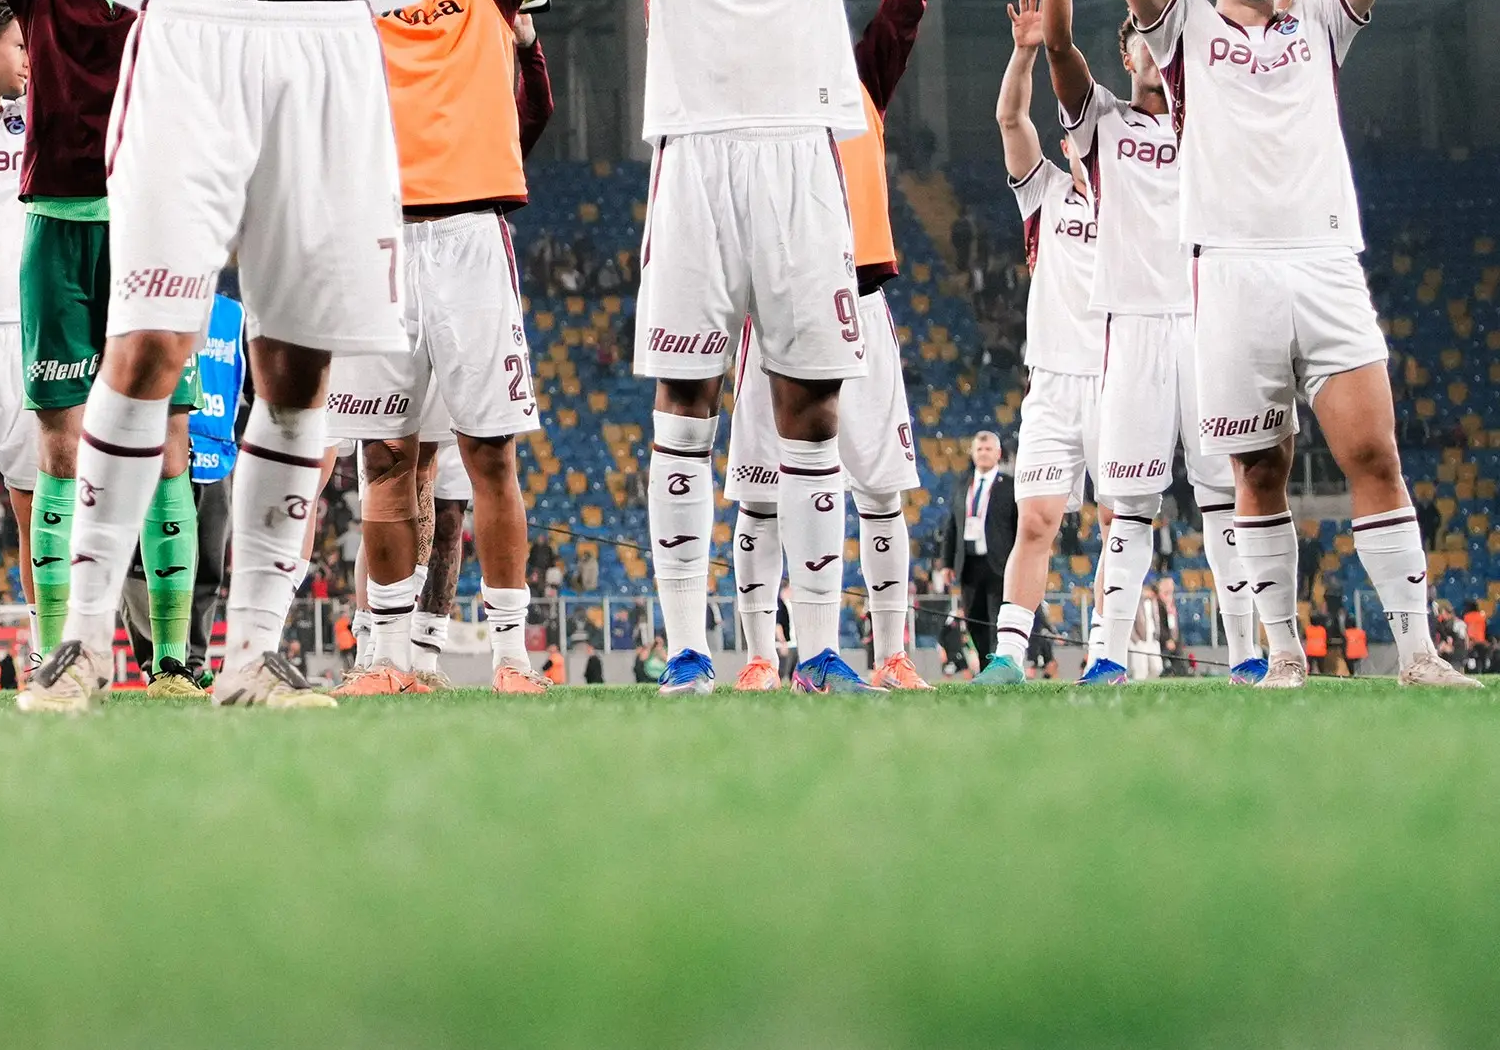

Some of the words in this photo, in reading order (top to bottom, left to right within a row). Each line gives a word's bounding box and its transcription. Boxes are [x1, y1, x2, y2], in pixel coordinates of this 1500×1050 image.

[1117, 138, 1177, 169] pap
[377, 238, 397, 302] 7
[834, 288, 860, 342] 9
[648, 328, 701, 353] Rent
[701, 331, 728, 354] Go
[43, 358, 88, 381] Rent
[504, 352, 534, 402] 2
[337, 394, 382, 414] Rent
[384, 394, 410, 414] Go
[1213, 415, 1260, 437] Rent
[1263, 408, 1284, 430] Go
[1045, 465, 1063, 480] Go
[1109, 461, 1145, 478] Rent
[1147, 459, 1167, 477] Go
